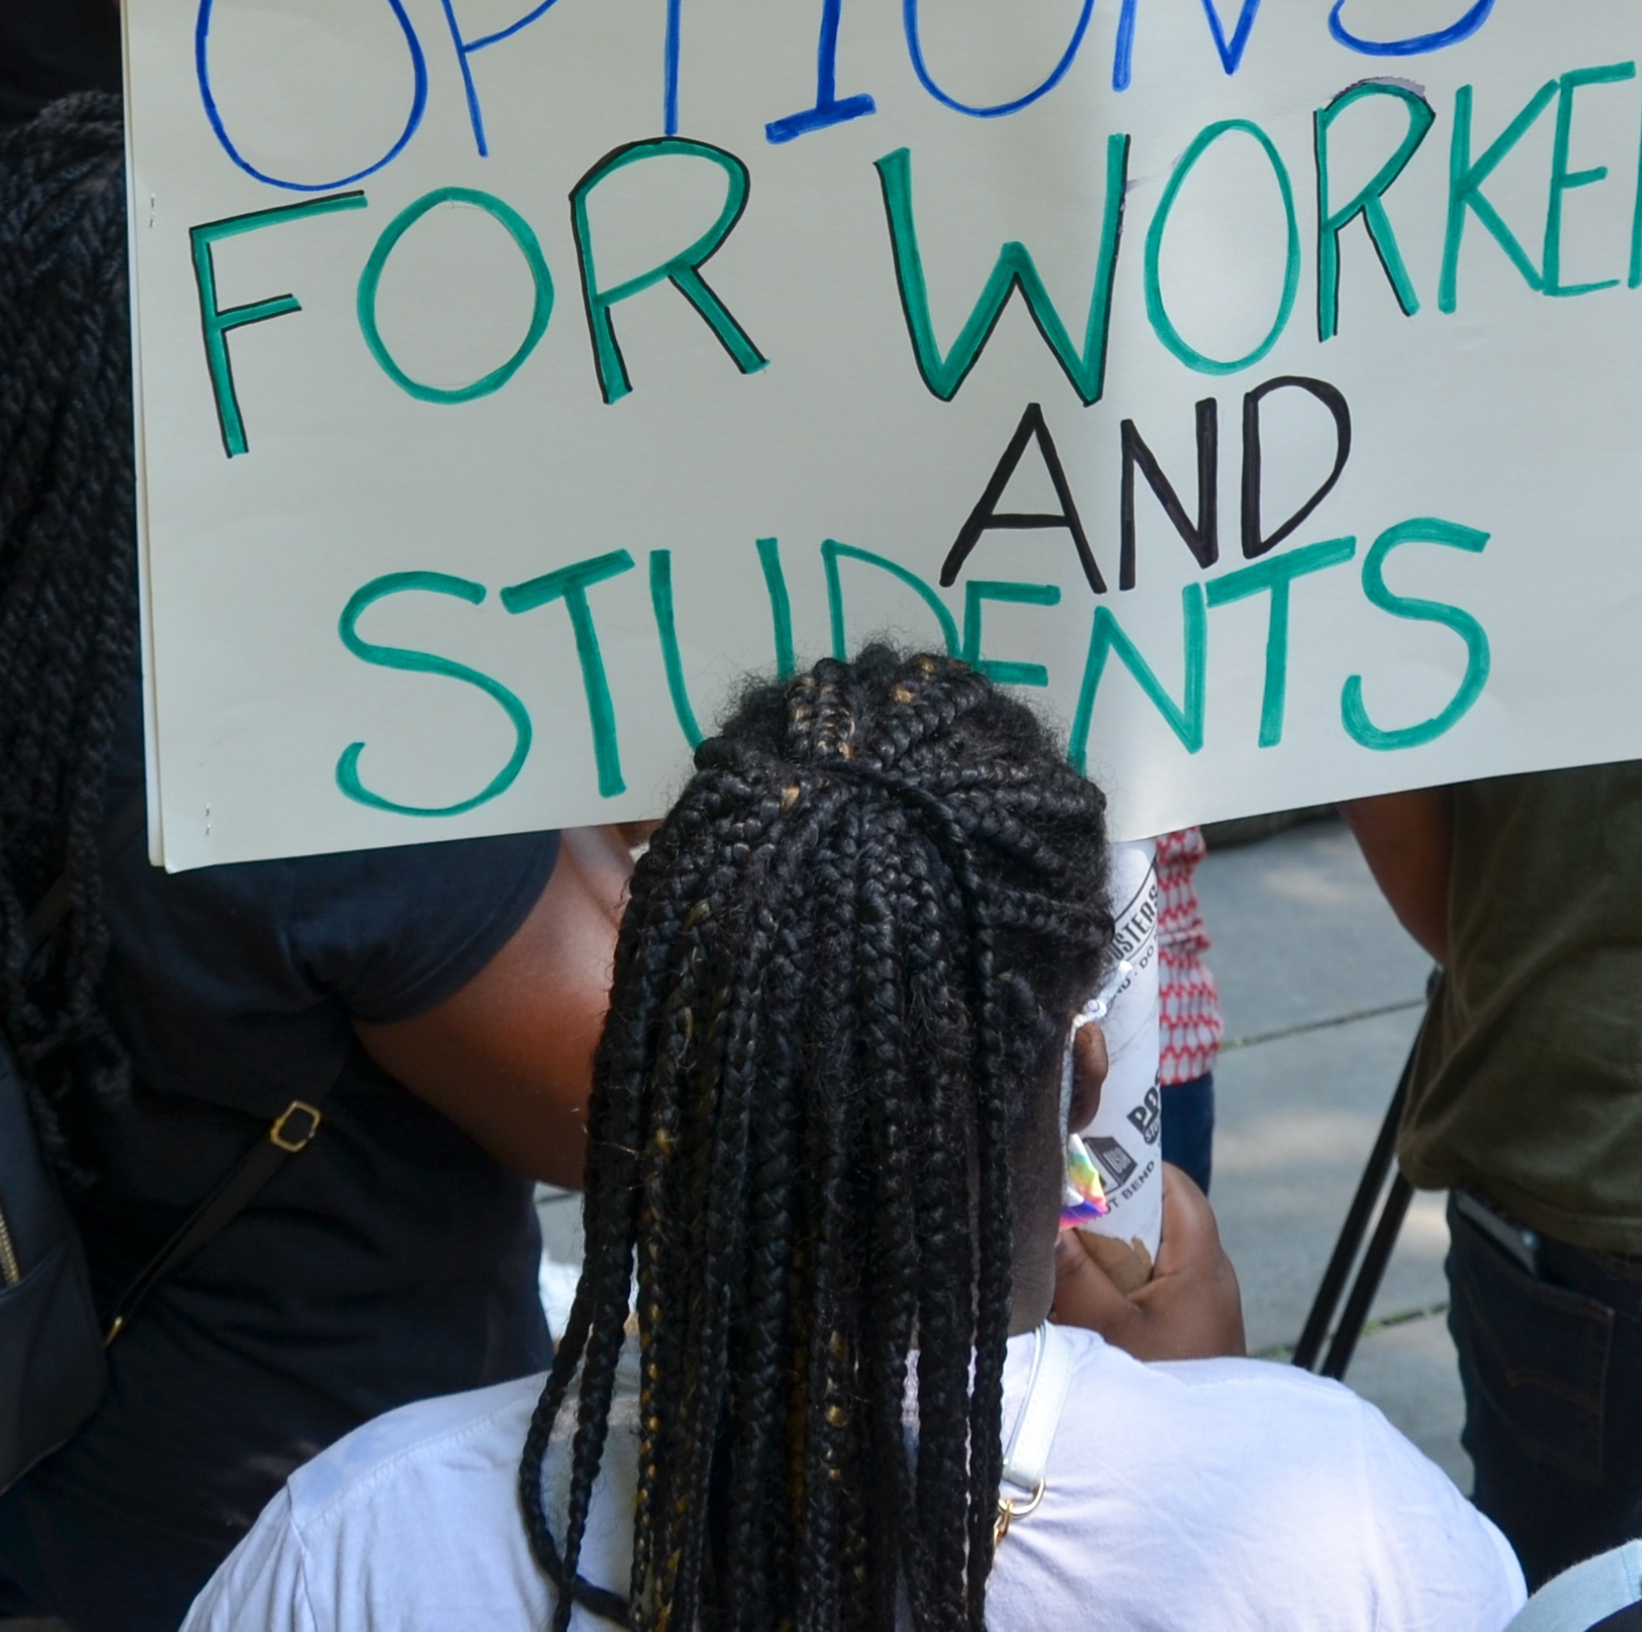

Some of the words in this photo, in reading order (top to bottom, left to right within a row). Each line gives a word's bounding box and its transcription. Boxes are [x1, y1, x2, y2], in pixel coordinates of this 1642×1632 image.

[189, 137, 770, 458] FOR
[939, 375, 1352, 594] AND
[1121, 1160, 1156, 1201] BEND
